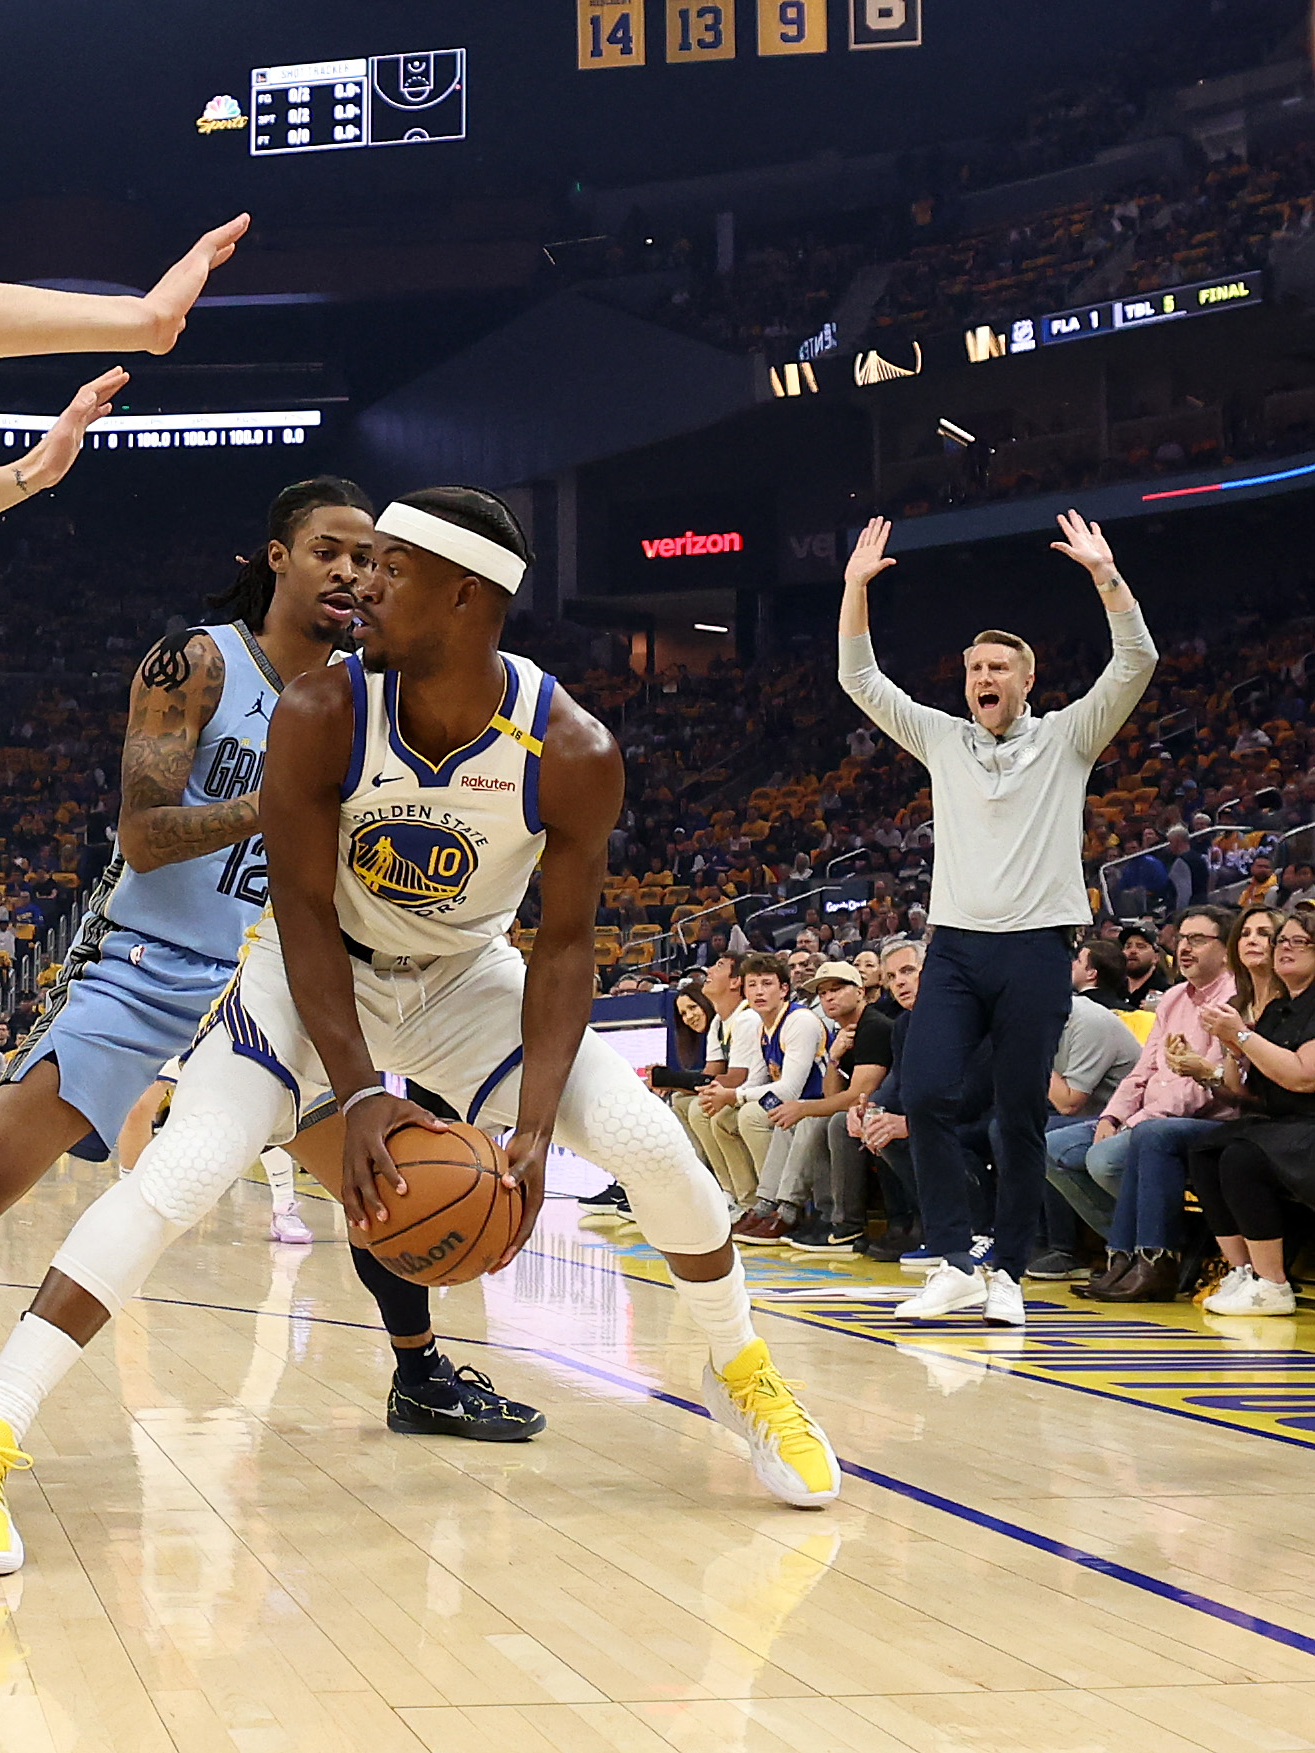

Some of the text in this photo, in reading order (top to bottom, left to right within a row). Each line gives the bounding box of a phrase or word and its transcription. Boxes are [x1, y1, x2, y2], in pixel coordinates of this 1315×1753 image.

[678, 6, 723, 51] 13
[780, 0, 807, 43] 9
[590, 12, 633, 57] 14
[281, 63, 350, 79] SHOT TRACKER
[258, 94, 272, 104] FG
[288, 87, 310, 103] 0/2
[196, 115, 248, 134] Sports
[258, 114, 276, 125] 3PT
[288, 108, 310, 124] 0/2
[257, 135, 270, 146] FT
[287, 128, 310, 144] 0/0
[1050, 317, 1080, 335] FLA
[1089, 310, 1099, 328] 1
[1124, 301, 1155, 319] TBL
[1198, 282, 1249, 305] FINAL
[5, 432, 14, 446] 0
[108, 433, 117, 448] 0
[137, 431, 170, 447] 100.0
[184, 430, 217, 446] 100.0
[230, 429, 263, 445] 100.0
[283, 428, 304, 443] 0.0
[642, 531, 743, 558] verizon
[510, 727, 523, 740] 16
[461, 776, 516, 792] Rakuten
[353, 804, 489, 848] GOLDEN STATE
[216, 837, 268, 907] 12
[427, 845, 462, 877] 10
